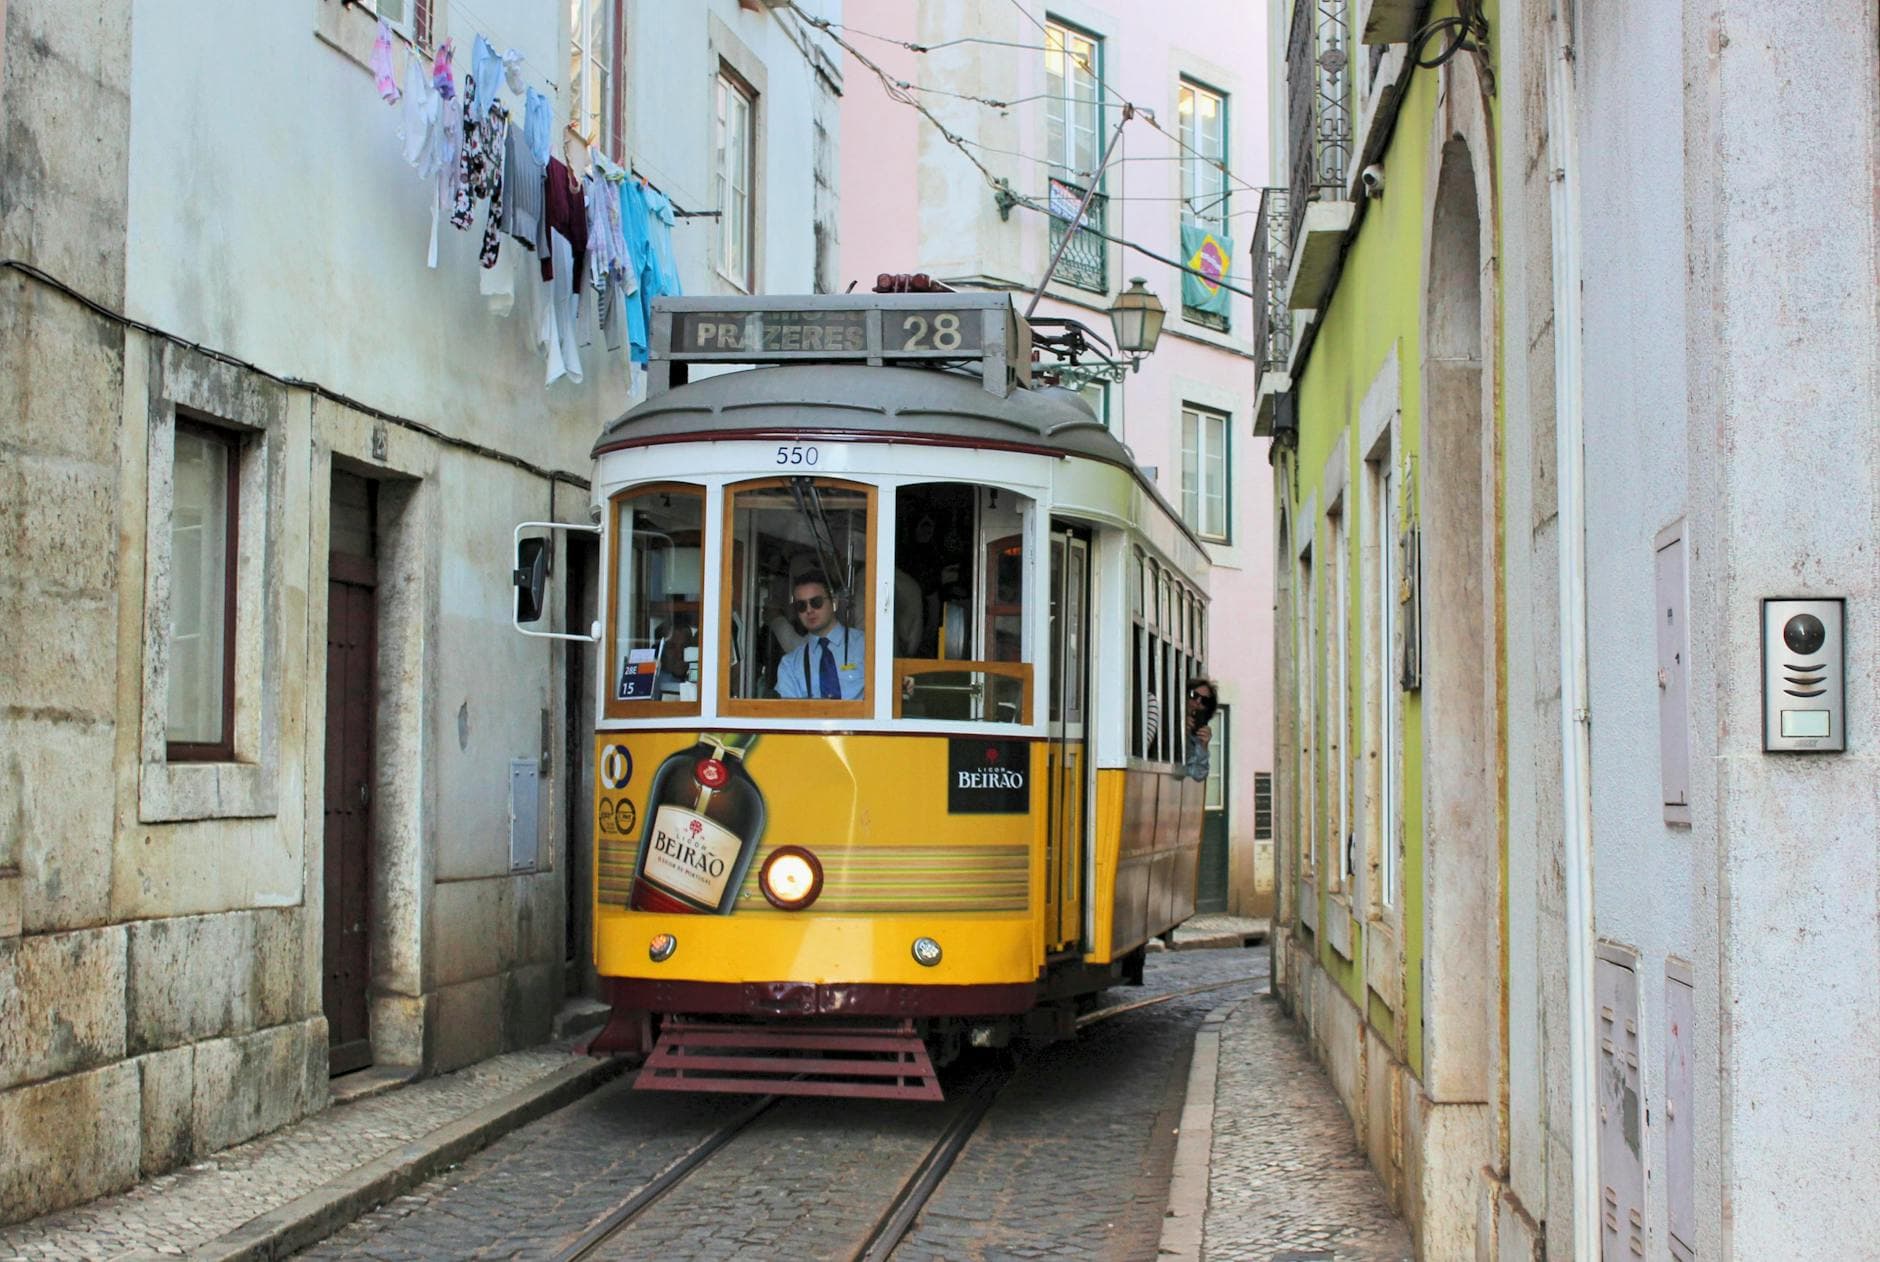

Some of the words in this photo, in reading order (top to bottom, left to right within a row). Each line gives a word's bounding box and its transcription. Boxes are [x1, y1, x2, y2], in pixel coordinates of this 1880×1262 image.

[903, 312, 961, 351] 28
[776, 446, 819, 466] 550
[622, 682, 635, 695] 15
[958, 770, 1023, 789] BEIRÃO
[655, 831, 724, 877] BEIRÃO
